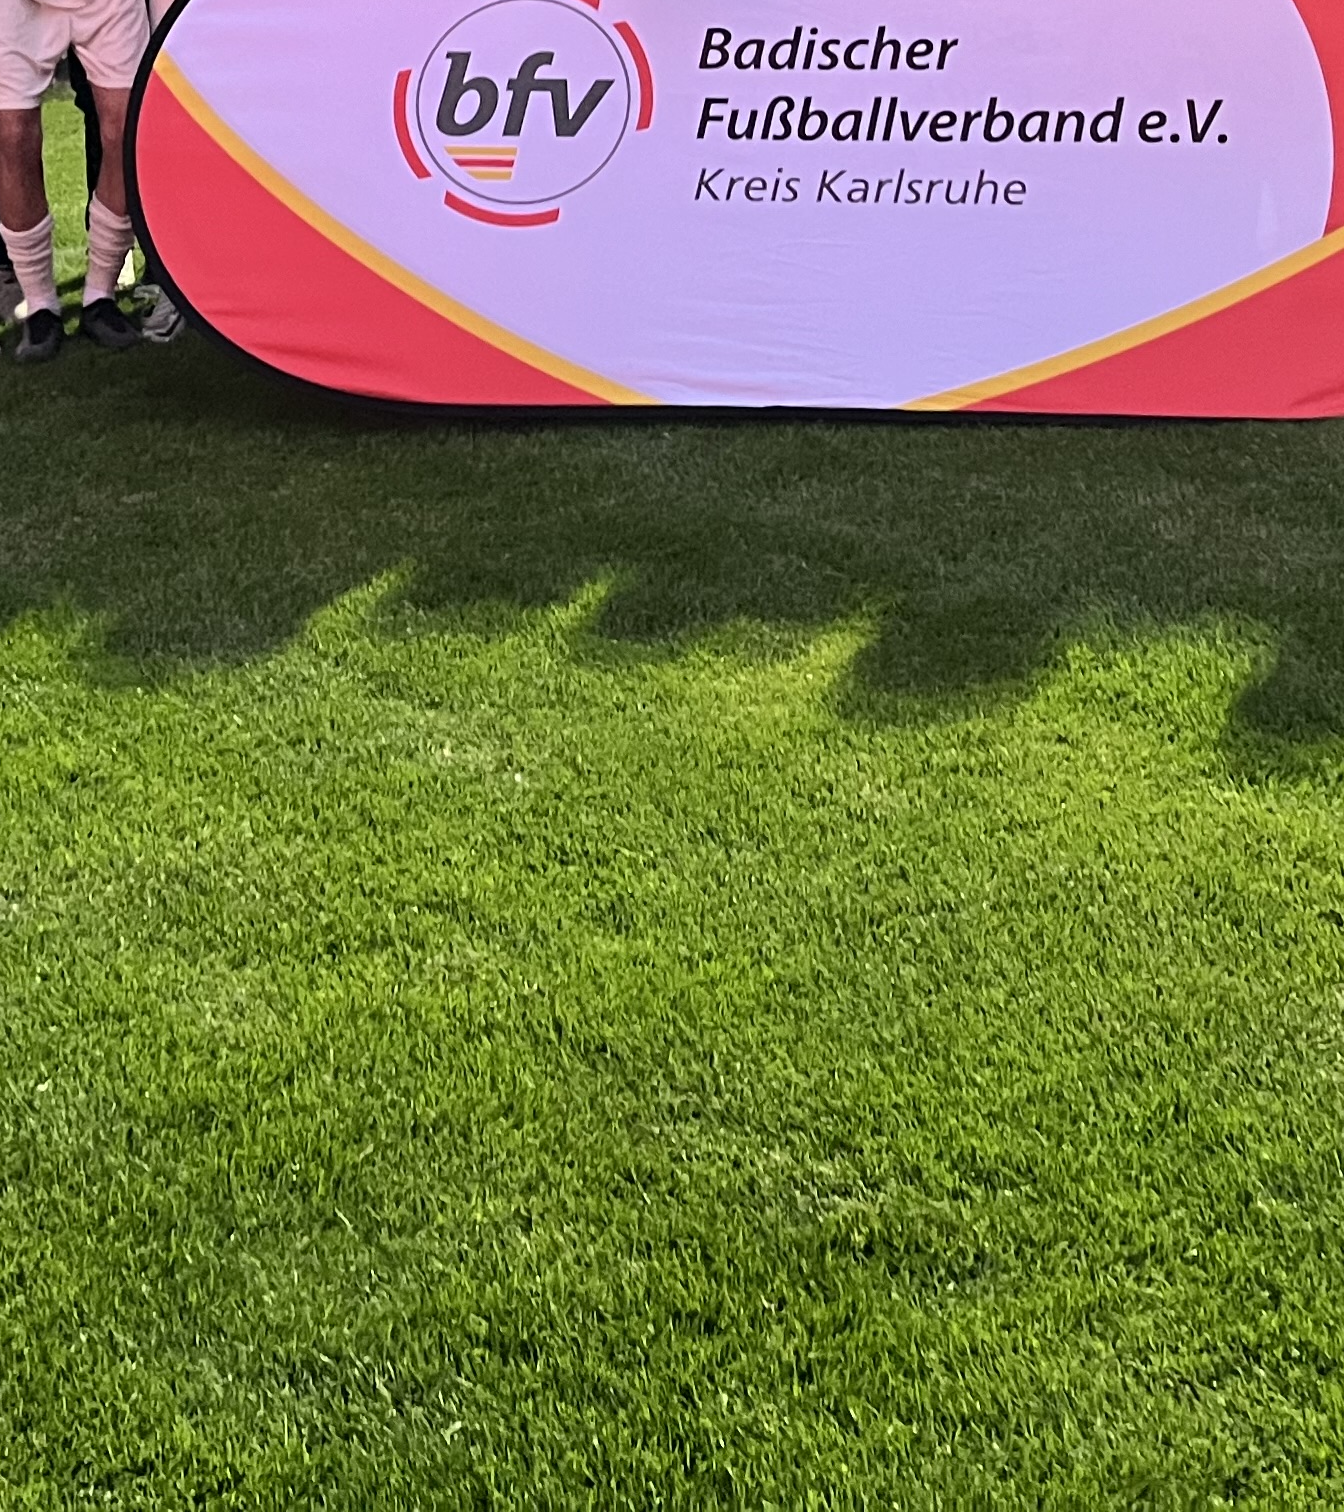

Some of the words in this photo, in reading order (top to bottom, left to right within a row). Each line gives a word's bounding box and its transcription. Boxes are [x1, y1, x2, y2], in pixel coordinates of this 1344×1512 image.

[698, 25, 959, 71] Badischer
[435, 50, 616, 138] bfv
[696, 95, 1125, 144] Fußballverband
[1137, 99, 1229, 144] e.V.
[694, 167, 801, 203] Kreis
[815, 169, 1027, 206] Karlsruhe
